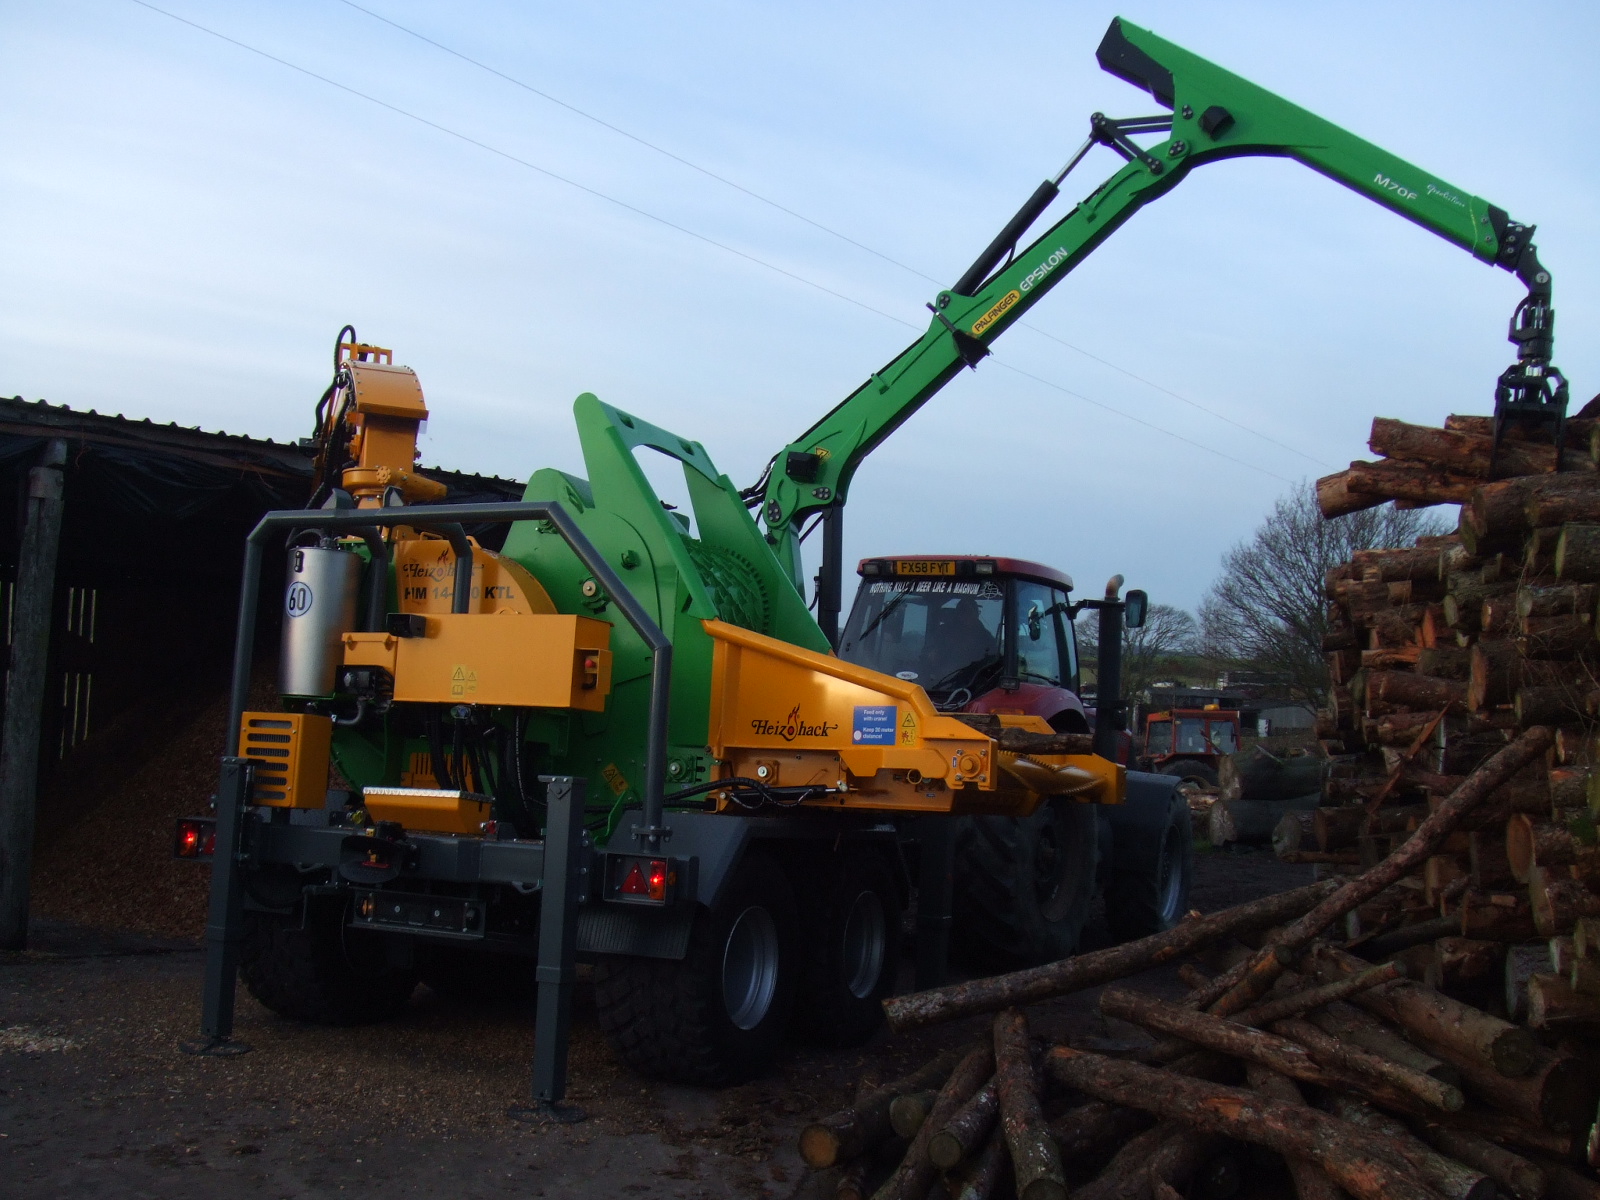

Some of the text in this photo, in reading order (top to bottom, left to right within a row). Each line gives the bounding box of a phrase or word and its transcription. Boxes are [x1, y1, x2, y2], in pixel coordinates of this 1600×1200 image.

[1374, 174, 1418, 200] M70F
[974, 247, 1068, 332] PALFINGER EPSILON
[901, 562, 951, 573] FX58 FYT
[289, 587, 306, 611] 60
[404, 586, 427, 599] HM
[485, 586, 514, 599] KTL
[869, 582, 893, 593] NOTHING
[916, 581, 932, 592] DEER
[932, 582, 947, 593] LIKE
[947, 582, 953, 593] A
[953, 583, 981, 595] MAGNUM
[751, 718, 839, 742] Heizohack
